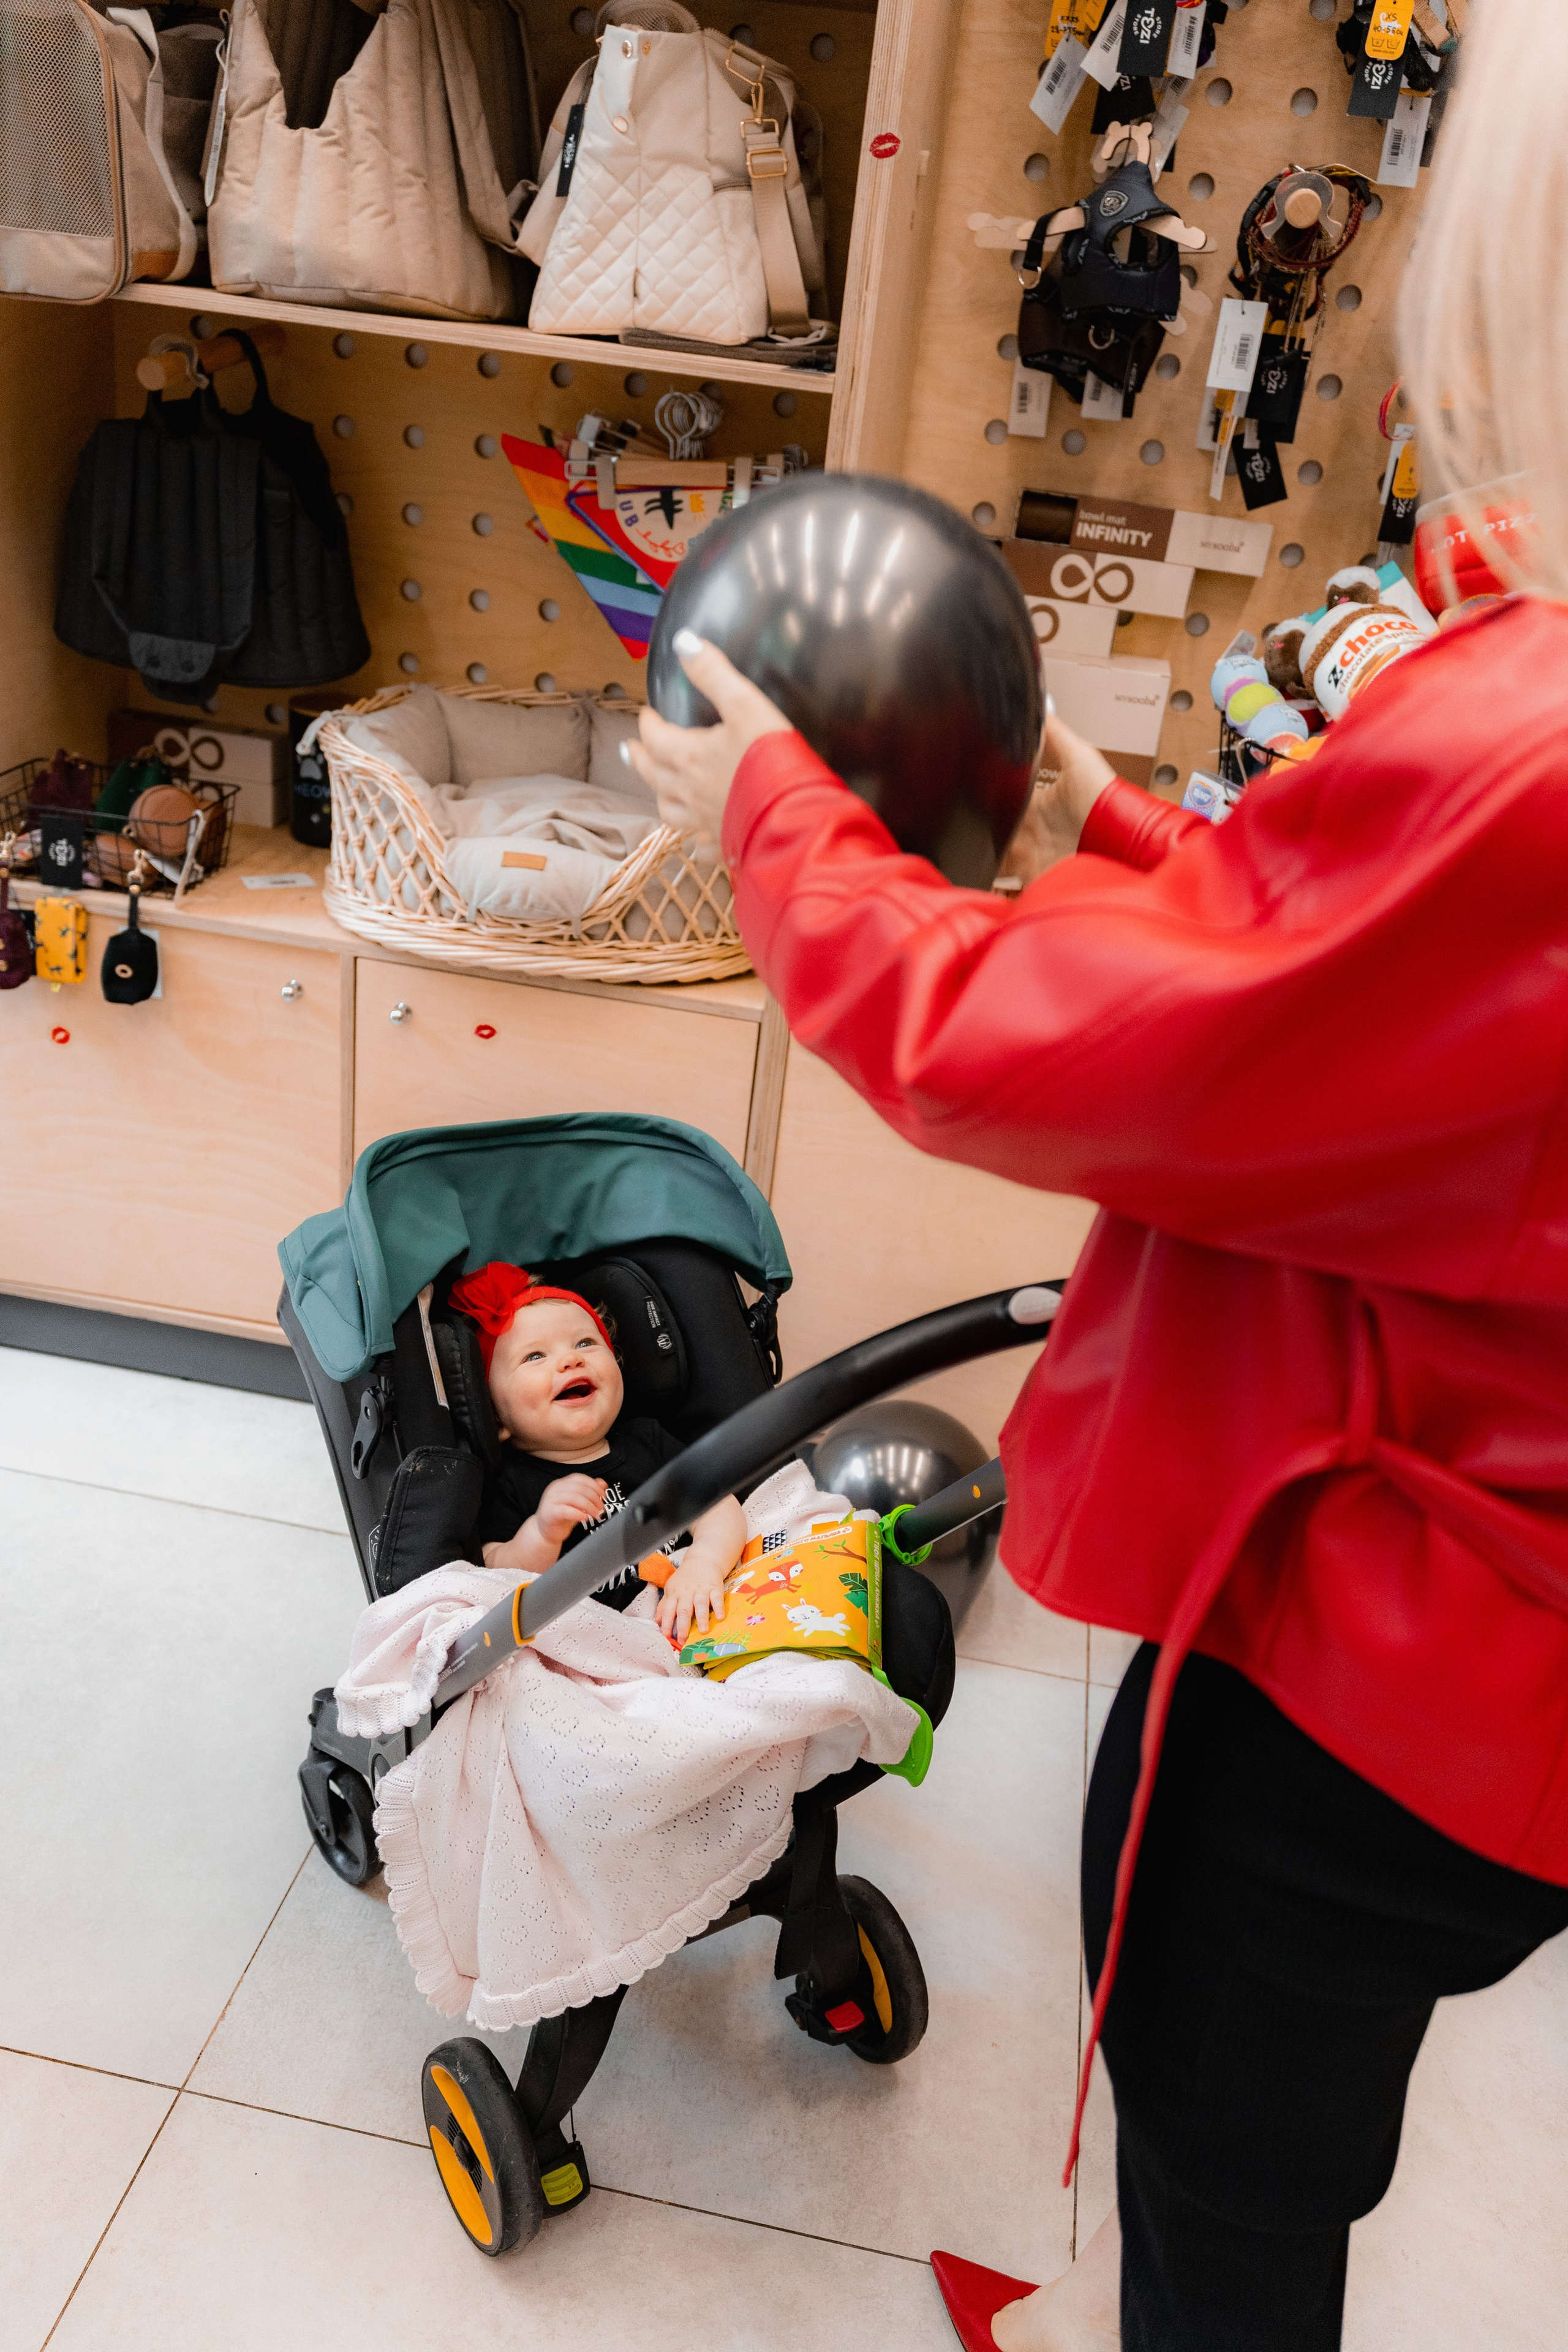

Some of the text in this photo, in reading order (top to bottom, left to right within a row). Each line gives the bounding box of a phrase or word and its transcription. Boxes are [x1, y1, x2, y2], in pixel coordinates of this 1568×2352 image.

[1076, 521, 1153, 548] INFINITY
[1339, 638, 1383, 694] chocolate
[646, 1302, 657, 1328] PROTECTION
[784, 1538, 809, 1548] ВАШЕГО
[810, 1530, 841, 1541] МАЛЫША
